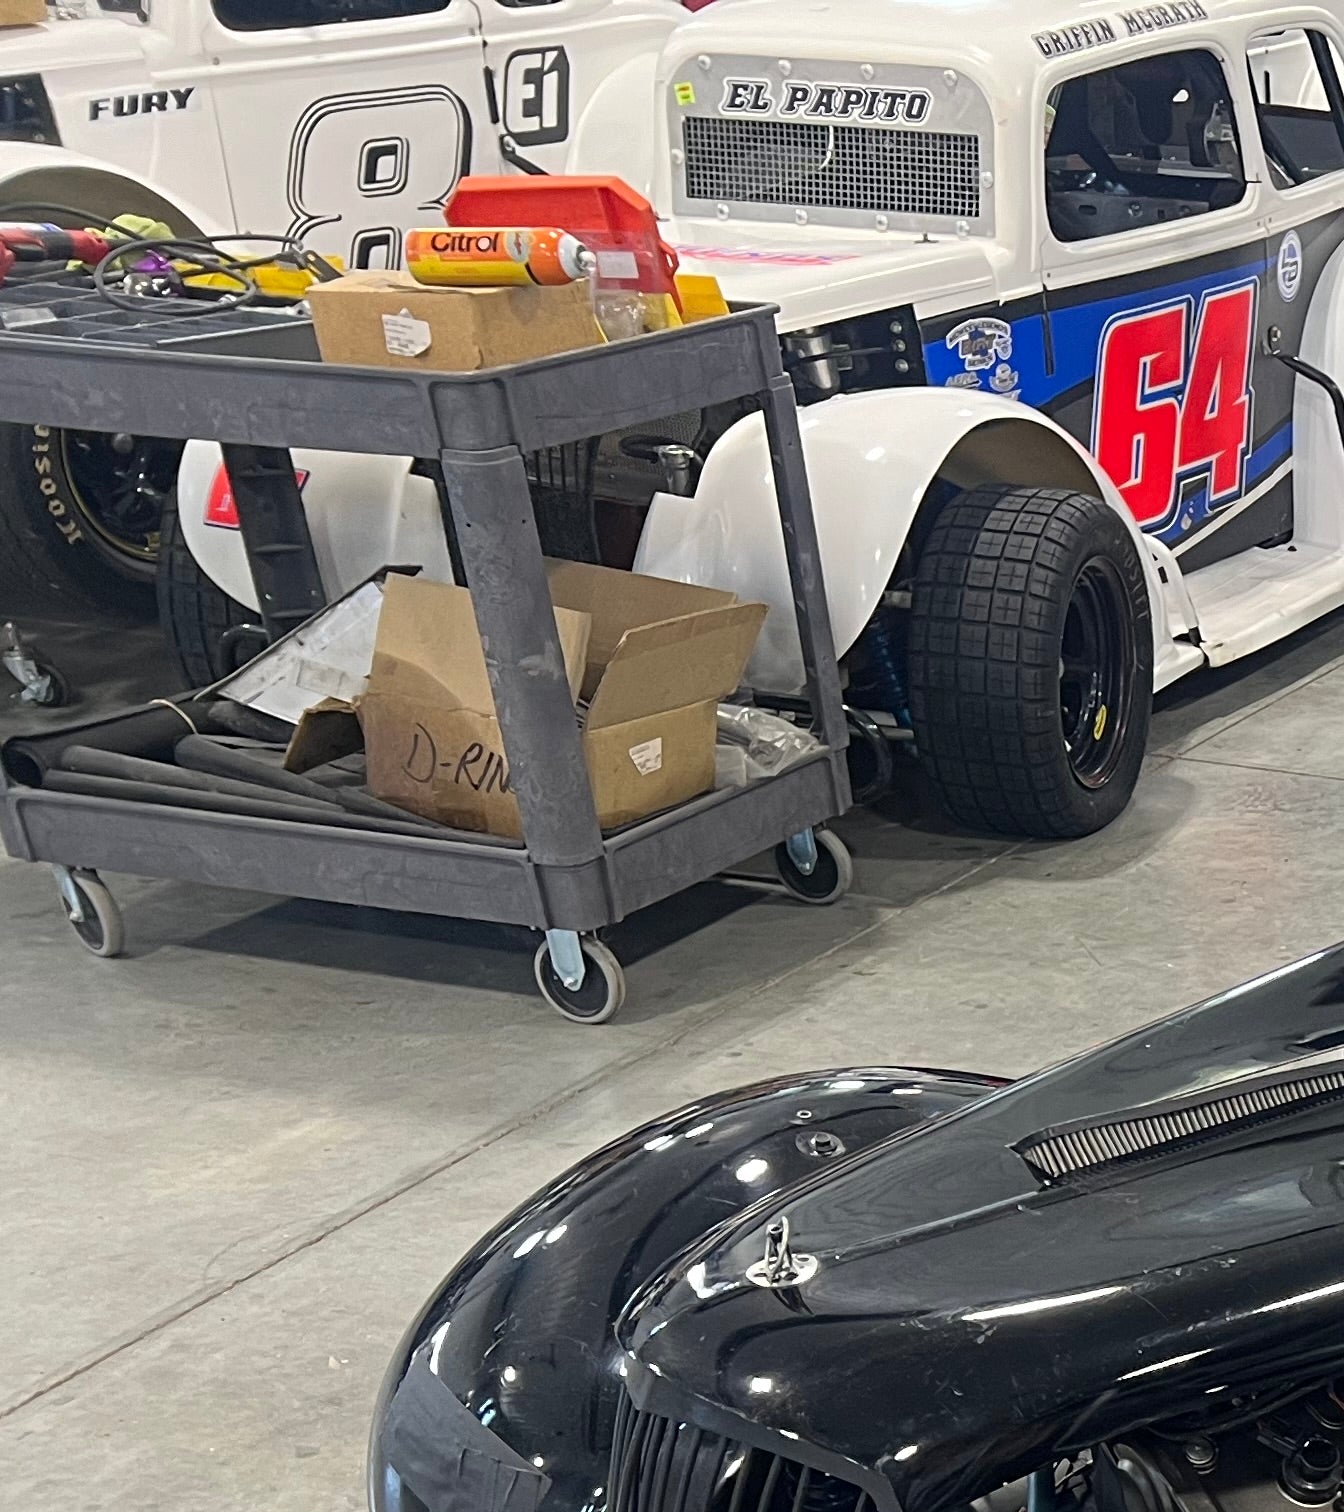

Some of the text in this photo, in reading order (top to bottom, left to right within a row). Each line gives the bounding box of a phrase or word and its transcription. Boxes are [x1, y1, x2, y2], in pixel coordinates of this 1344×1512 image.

[1033, 0, 1208, 57] GRIFFIN MCGRATH
[89, 87, 195, 121] FURY
[721, 79, 773, 113] EL
[779, 80, 931, 123] PAPITO
[430, 231, 500, 253] Citrol
[1090, 276, 1260, 535] 64
[400, 722, 511, 794] D-RIN
